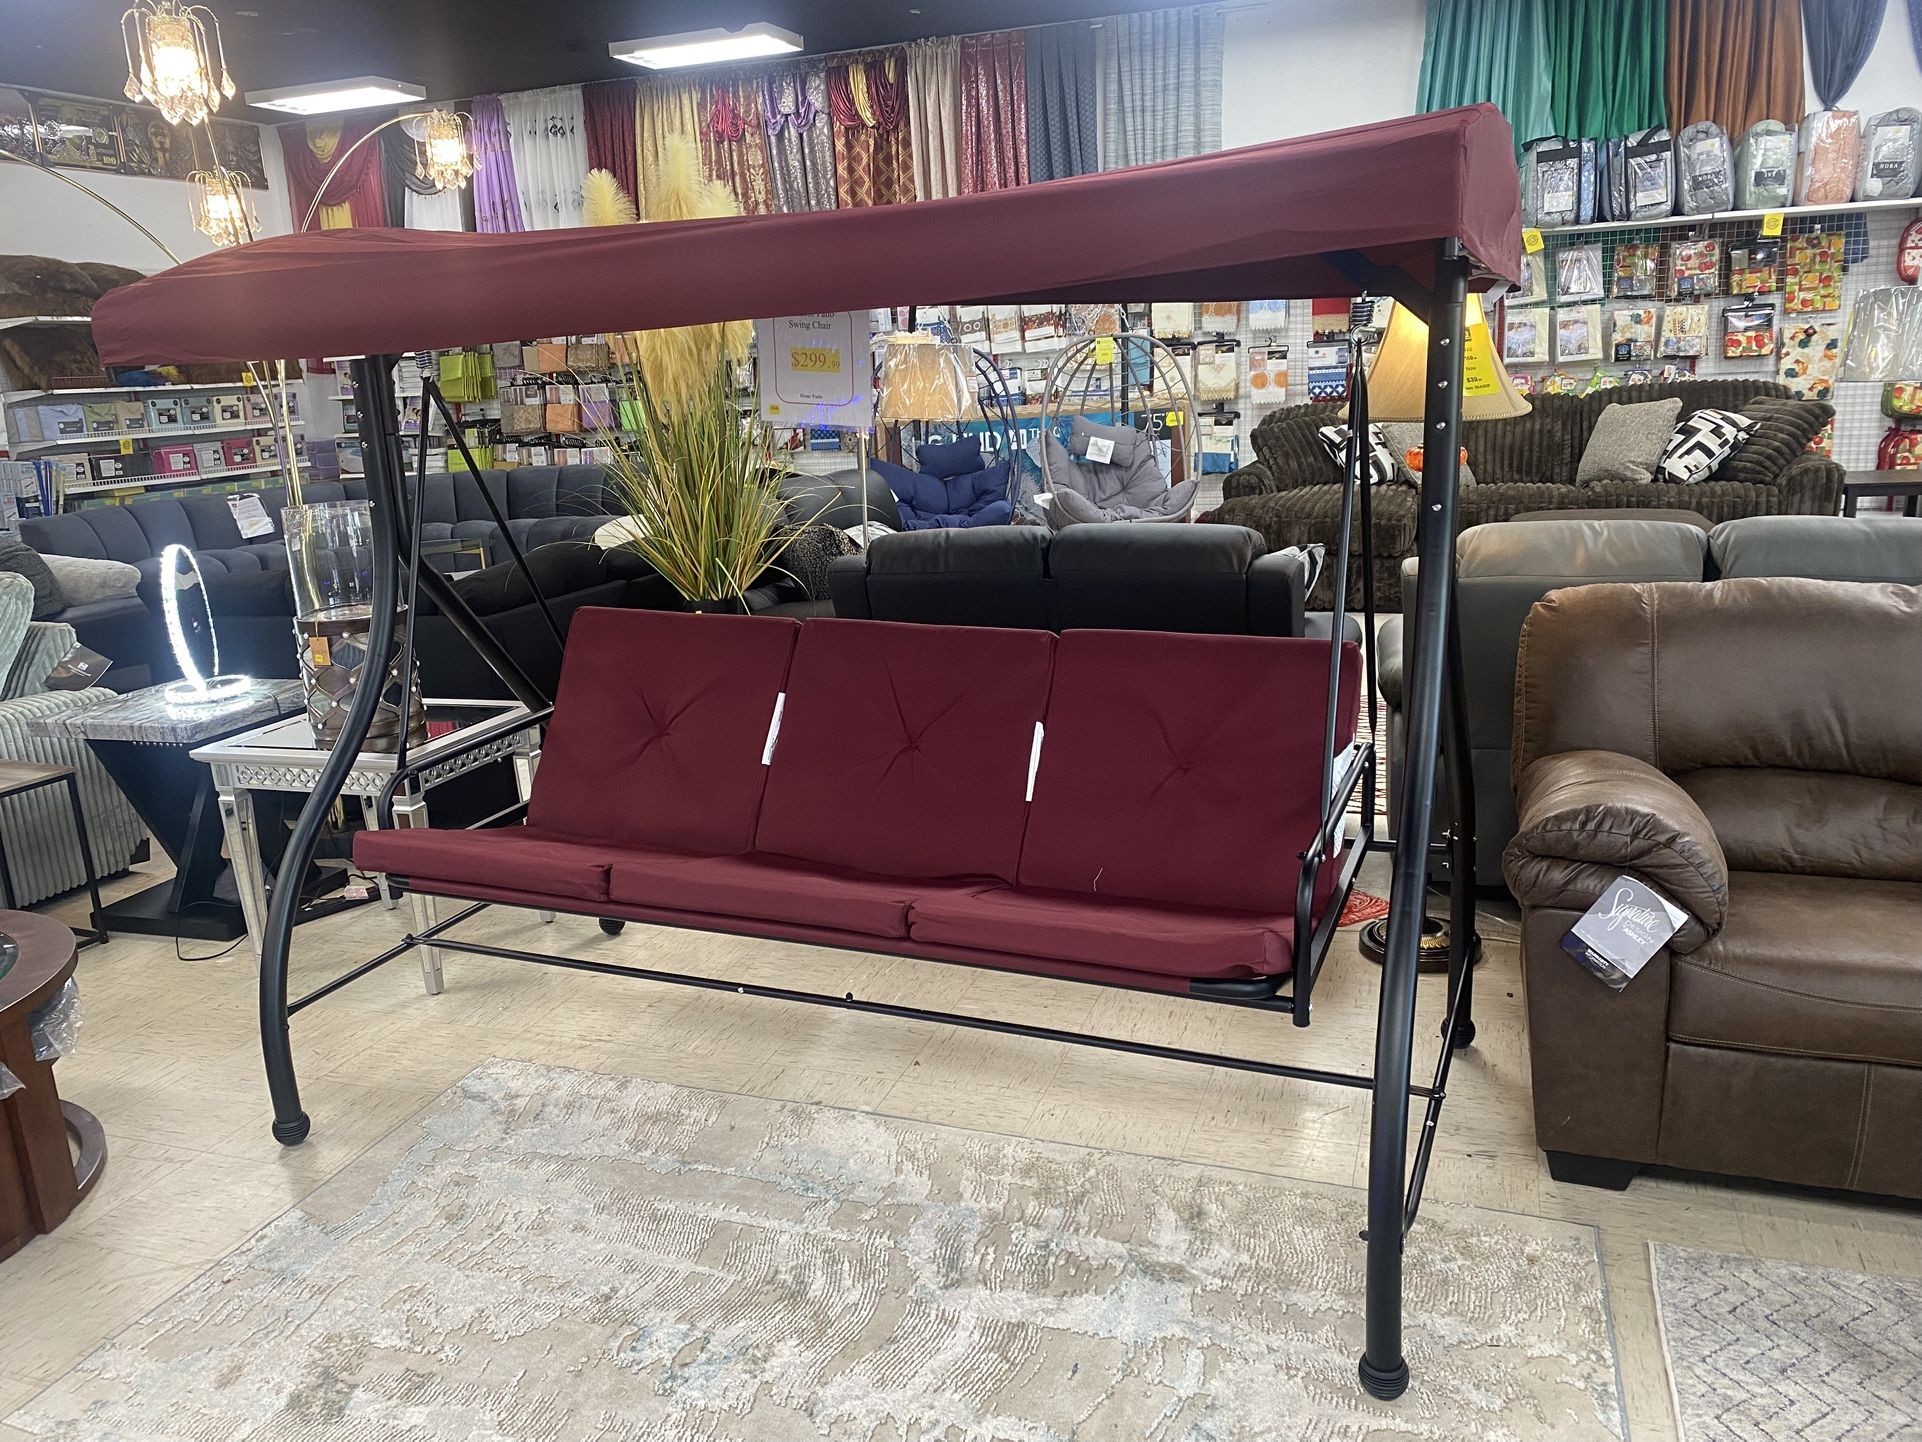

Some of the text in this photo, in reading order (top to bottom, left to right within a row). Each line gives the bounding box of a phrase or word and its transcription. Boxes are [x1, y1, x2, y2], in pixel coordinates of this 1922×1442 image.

[789, 320, 832, 331] Swing Chair
[791, 351, 841, 369] $299.99
[1598, 887, 1661, 933] Signature
